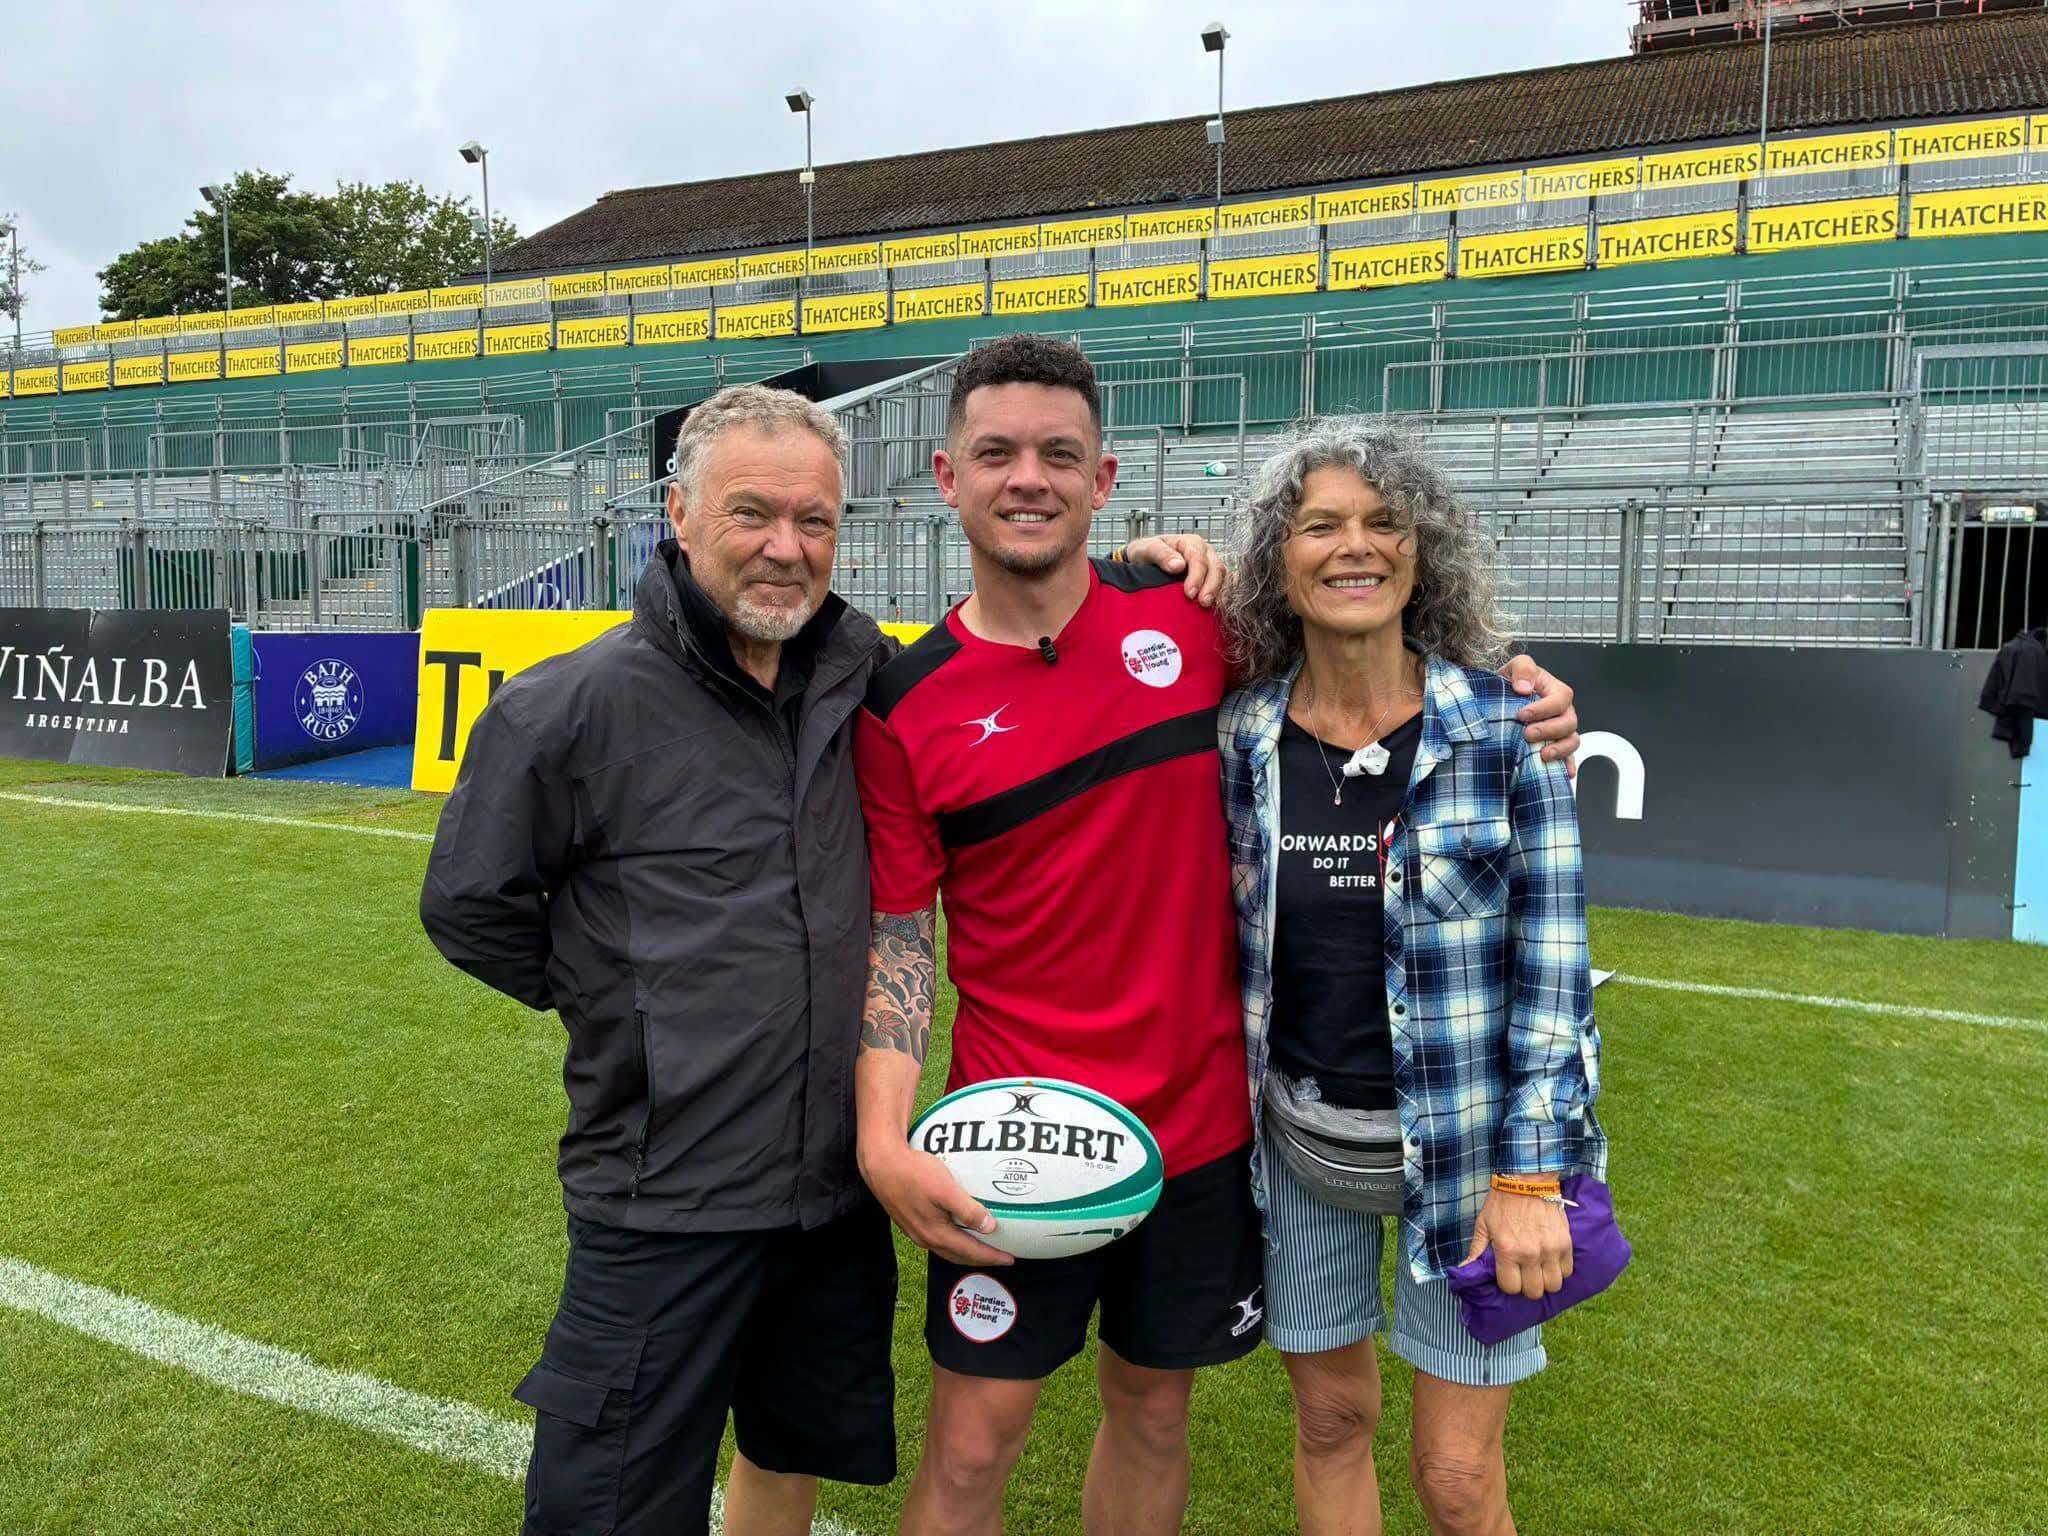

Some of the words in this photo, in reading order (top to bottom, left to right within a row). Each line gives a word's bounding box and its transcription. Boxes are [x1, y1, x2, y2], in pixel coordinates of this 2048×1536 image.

[1899, 127, 2020, 156] THATCHERS
[1770, 141, 1887, 169] THATCHERS
[1646, 153, 1757, 182] THATCHERS
[1529, 167, 1634, 195] THATCHERS
[1422, 180, 1519, 207] THATCHERS
[1318, 191, 1410, 218] THATCHERS
[1222, 204, 1309, 229] THATCHERS
[1913, 200, 2048, 230] THATCHER
[1044, 223, 1121, 244] THATCHERS
[1130, 216, 1212, 237] THATCHERS
[1752, 210, 1895, 244] THATCHERS
[962, 232, 1037, 254] THATCHERS
[1600, 223, 1734, 259] THATCHERS
[811, 249, 878, 270] THATCHERS
[885, 240, 955, 263] THATCHERS
[1461, 238, 1584, 270] THATCHERS
[673, 265, 735, 284] THATCHERS
[742, 256, 805, 276] THATCHERS
[1332, 251, 1445, 282] THATCHERS
[549, 278, 603, 296] THATCHERS
[609, 272, 668, 290] THATCHERS
[1099, 273, 1198, 301] THATCHERS
[1211, 264, 1316, 290] THATCHERS
[432, 290, 482, 309] THATCHERS
[489, 284, 541, 302] THATCHERS
[995, 284, 1087, 309] THATCHERS
[326, 304, 374, 319] THATCHERS
[379, 296, 427, 315] THATCHERS
[804, 302, 885, 322] THATCHERS
[896, 294, 983, 317] THATCHERS
[182, 319, 224, 333] THATCHERS
[228, 314, 272, 328] THATCHERS
[276, 308, 322, 325] THATCHERS
[717, 310, 793, 333] THATCHERS
[55, 330, 92, 345] THATCHERS
[95, 327, 135, 342] THATCHERS
[138, 323, 178, 338] THATCHERS
[559, 324, 627, 345] THATCHERS
[636, 319, 708, 340] THATCHERS
[416, 338, 478, 358] THATCHERS
[485, 331, 550, 352] THATCHERS
[287, 349, 343, 367] THATCHERS
[349, 343, 408, 362] THATCHERS
[115, 364, 163, 381] THATCHERS
[169, 359, 220, 376] THATCHERS
[227, 355, 280, 372] THATCHERS
[15, 374, 58, 390] THATCHERS
[64, 369, 109, 385] THATCHERS
[1138, 643, 1166, 654] Cardiac
[1142, 653, 1159, 661] Risk
[304, 661, 354, 686] BATH
[1146, 658, 1169, 669] Young
[25, 713, 129, 734] ARGENTINA
[302, 708, 356, 738] RUGBY
[1280, 834, 1377, 851] ORWARDS
[1313, 857, 1334, 869] DO
[1337, 857, 1349, 869] IT
[1329, 875, 1376, 888] BETTER
[923, 1120, 1125, 1164] GILBERT
[1003, 1173, 1027, 1181] ATOM
[1497, 1180, 1516, 1190] Jamie
[973, 1301, 991, 1312] Risk
[992, 1306, 1000, 1314] in
[1001, 1308, 1014, 1317] the
[974, 1293, 1006, 1307] Cardiac
[973, 1310, 998, 1323] Young
